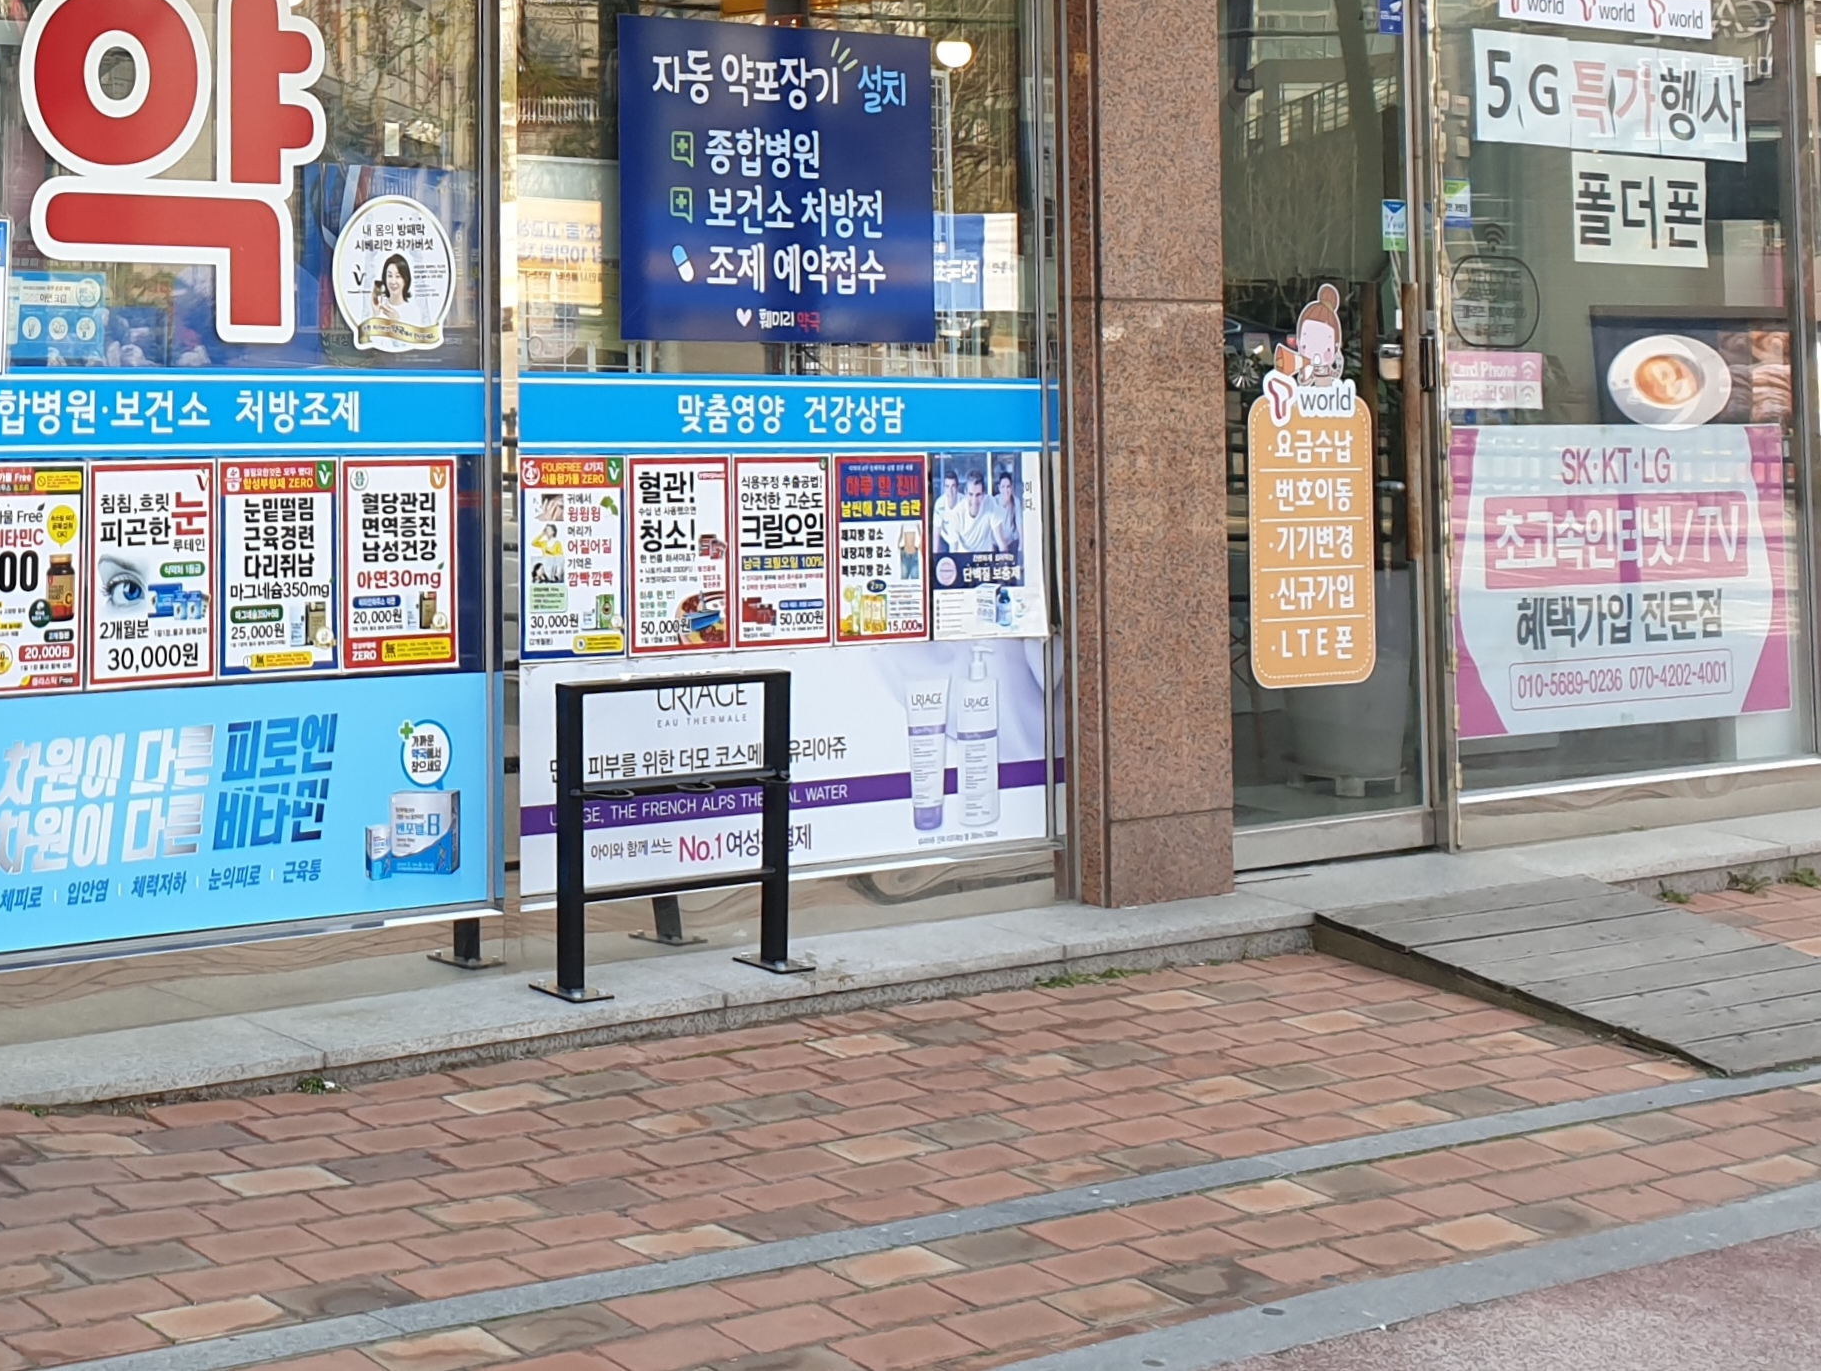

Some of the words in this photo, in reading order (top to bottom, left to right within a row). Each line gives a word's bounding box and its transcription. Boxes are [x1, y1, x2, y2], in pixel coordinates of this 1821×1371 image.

[1598, 1, 1636, 24] world
[1667, 8, 1704, 31] world
[651, 49, 714, 107] 자동
[720, 52, 841, 111] 약포장기
[857, 64, 909, 114] 설치
[1571, 59, 1742, 142] 특가행사
[704, 128, 821, 180] 종합병원
[704, 186, 794, 236] 보건소
[800, 187, 885, 239] 처방전
[1574, 171, 1703, 250] 폴더폰
[363, 225, 371, 237] 내
[375, 224, 394, 236] 몸의
[397, 223, 426, 236] 방패막
[355, 240, 393, 252] 시베리안
[396, 238, 433, 251] 차가버섯
[706, 242, 767, 293] 조제
[773, 243, 888, 297] 예약접수
[758, 309, 795, 331] 훼미리
[797, 310, 821, 332] 약국
[1480, 363, 1517, 378] Phone
[235, 387, 362, 435] 처방조제
[1300, 386, 1352, 413] world
[676, 393, 786, 435] 맞춤영양
[803, 393, 906, 435] 건강상담
[1274, 429, 1354, 465] 요금수납
[542, 463, 582, 472] FOURFREE
[582, 475, 604, 484] ZERO
[288, 477, 314, 488] ZERO
[638, 470, 696, 504] 혈관!
[741, 476, 779, 489] 식용주정
[782, 475, 822, 489] 추출공법!
[361, 490, 436, 515] 혈당관리
[741, 492, 781, 511] 안전한
[785, 491, 823, 509] 고순도
[1275, 477, 1354, 513] 번호이동
[17, 509, 43, 523] Free
[100, 493, 170, 513] 침침,흐릿
[170, 491, 208, 536] 눈
[244, 497, 314, 523] 눈밑떨림
[100, 516, 172, 548] 피곤한
[244, 525, 314, 551] 근육경련
[361, 514, 437, 539] 면역증진
[567, 526, 592, 536] 머리가
[640, 519, 696, 553] 청소!
[740, 513, 824, 549] 크릴오일
[173, 538, 206, 553] 루테인
[361, 537, 437, 564] 남성건강
[567, 538, 612, 554] 어질어질
[1276, 525, 1355, 560] 기기변경
[244, 553, 315, 579] 다리쥐남
[764, 556, 798, 569] 크릴오일
[963, 567, 990, 582] 단백질
[992, 565, 1021, 580] 보충제
[230, 581, 330, 601] 마그네슘350mg
[356, 569, 442, 590] 아연30mg
[567, 571, 613, 587] 깜빡깜빡
[1276, 574, 1355, 611] 신규가입
[353, 609, 403, 624] 20,000원
[530, 613, 579, 629] 30,000원
[780, 611, 823, 625] 50,000원
[1516, 592, 1633, 652] 혜택가입
[1640, 587, 1723, 643] 전문점
[99, 619, 150, 640] 2개월분
[231, 623, 285, 640] 25,000원
[25, 646, 70, 659] 20,000원
[1281, 626, 1329, 660] LTE
[1335, 625, 1355, 660] 폰
[107, 642, 199, 673] 30,000원
[352, 650, 377, 662] ZERO
[1517, 669, 1624, 700] 010-5689-0236
[1629, 659, 1728, 692] 070-4202-4001
[911, 693, 942, 708] URIAGE
[963, 696, 989, 709] URIAGE
[656, 718, 679, 729] EAU
[685, 713, 749, 727] THERMALE
[130, 723, 216, 793] 다른
[220, 712, 339, 782] 피로엔
[411, 747, 442, 760] 약국에서
[588, 752, 639, 780] 피부를
[641, 749, 675, 776] 위한
[679, 746, 711, 772] 더모
[411, 759, 442, 774] 찾으세요
[610, 804, 637, 822] THE
[641, 798, 697, 819] FRENCH
[701, 795, 736, 813] ALPS
[805, 784, 848, 801] WATER
[121, 786, 207, 865] 다른
[212, 777, 331, 854] 비타민
[590, 841, 624, 861] 아이와
[626, 840, 648, 857] 함께
[650, 838, 673, 855] 쓰는
[678, 832, 723, 863] No.1
[66, 876, 110, 908] 입안염
[130, 869, 189, 900] 체력저하
[207, 864, 263, 893] 눈의피로
[281, 858, 324, 887] 근육통
